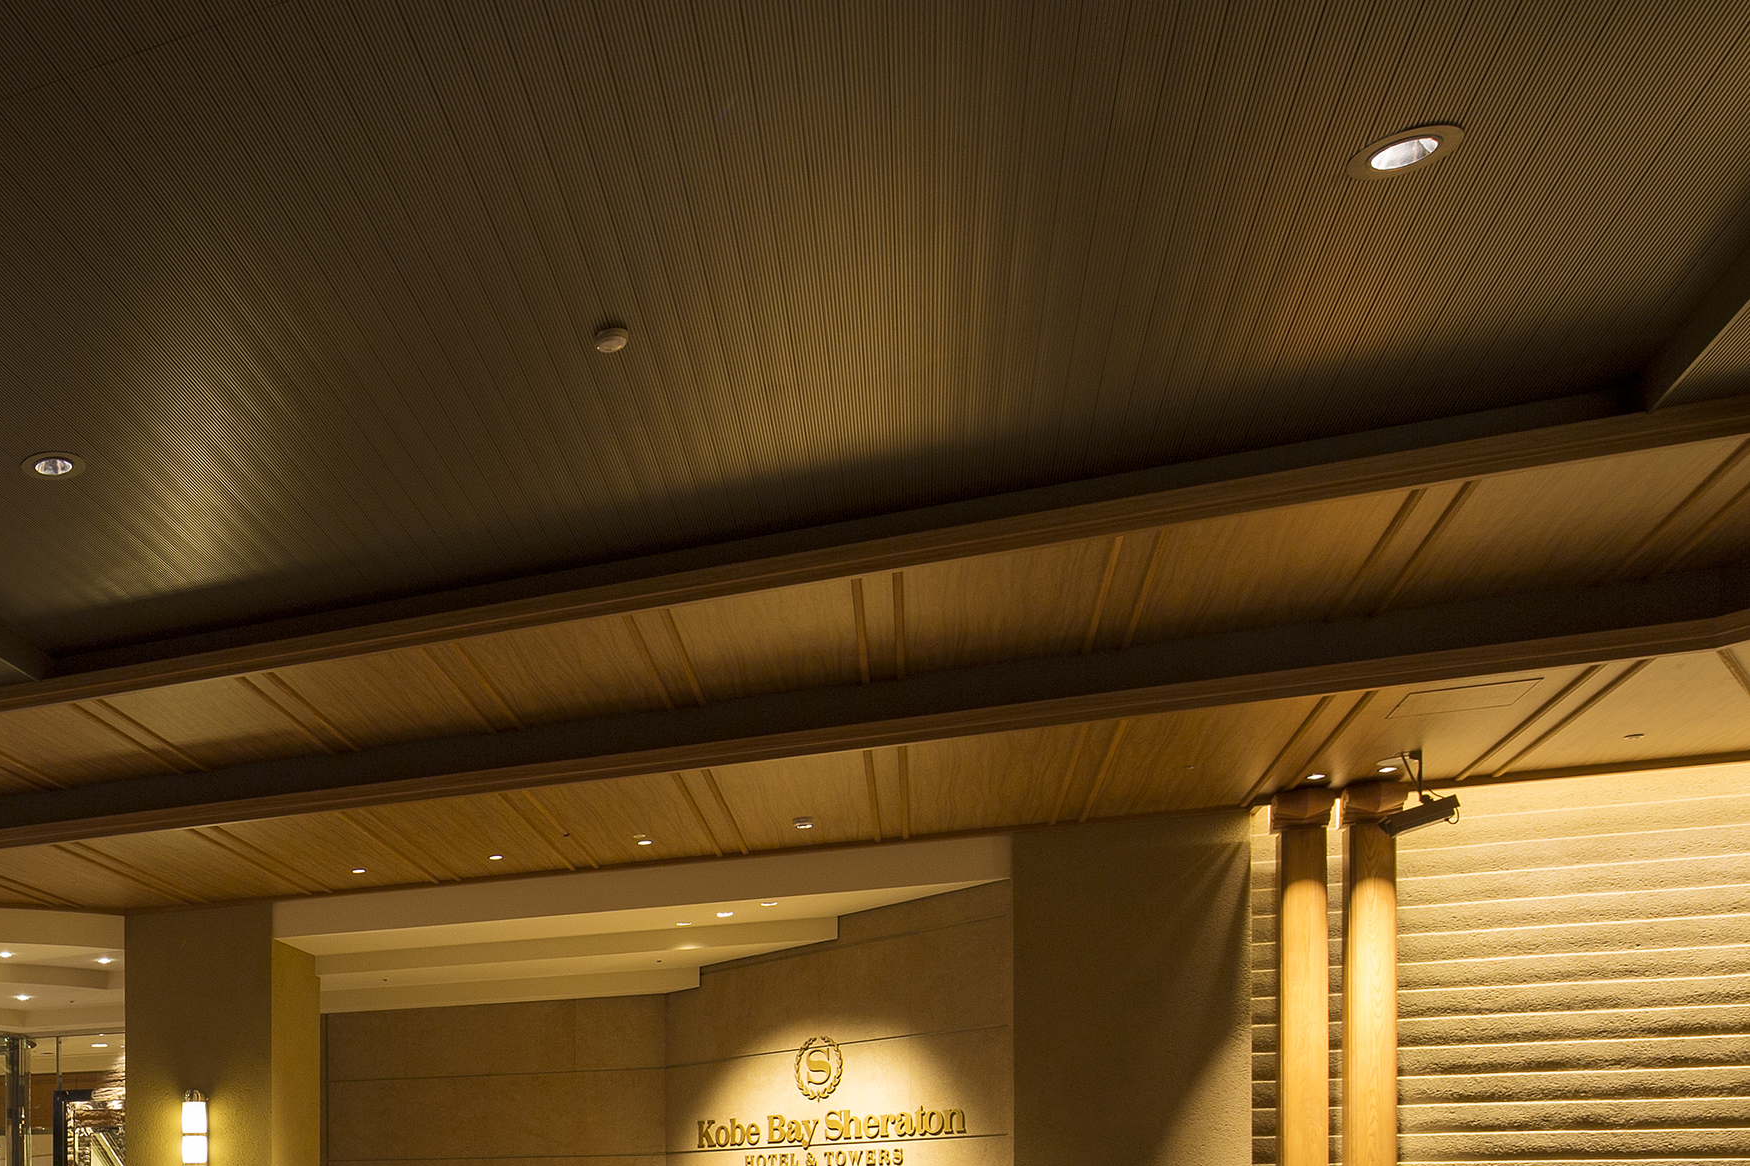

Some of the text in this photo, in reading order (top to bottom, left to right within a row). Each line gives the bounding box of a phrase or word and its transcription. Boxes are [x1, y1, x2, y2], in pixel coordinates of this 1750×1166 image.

[806, 1048, 831, 1085] S
[697, 1106, 967, 1150] Kobe Bay Sheraton
